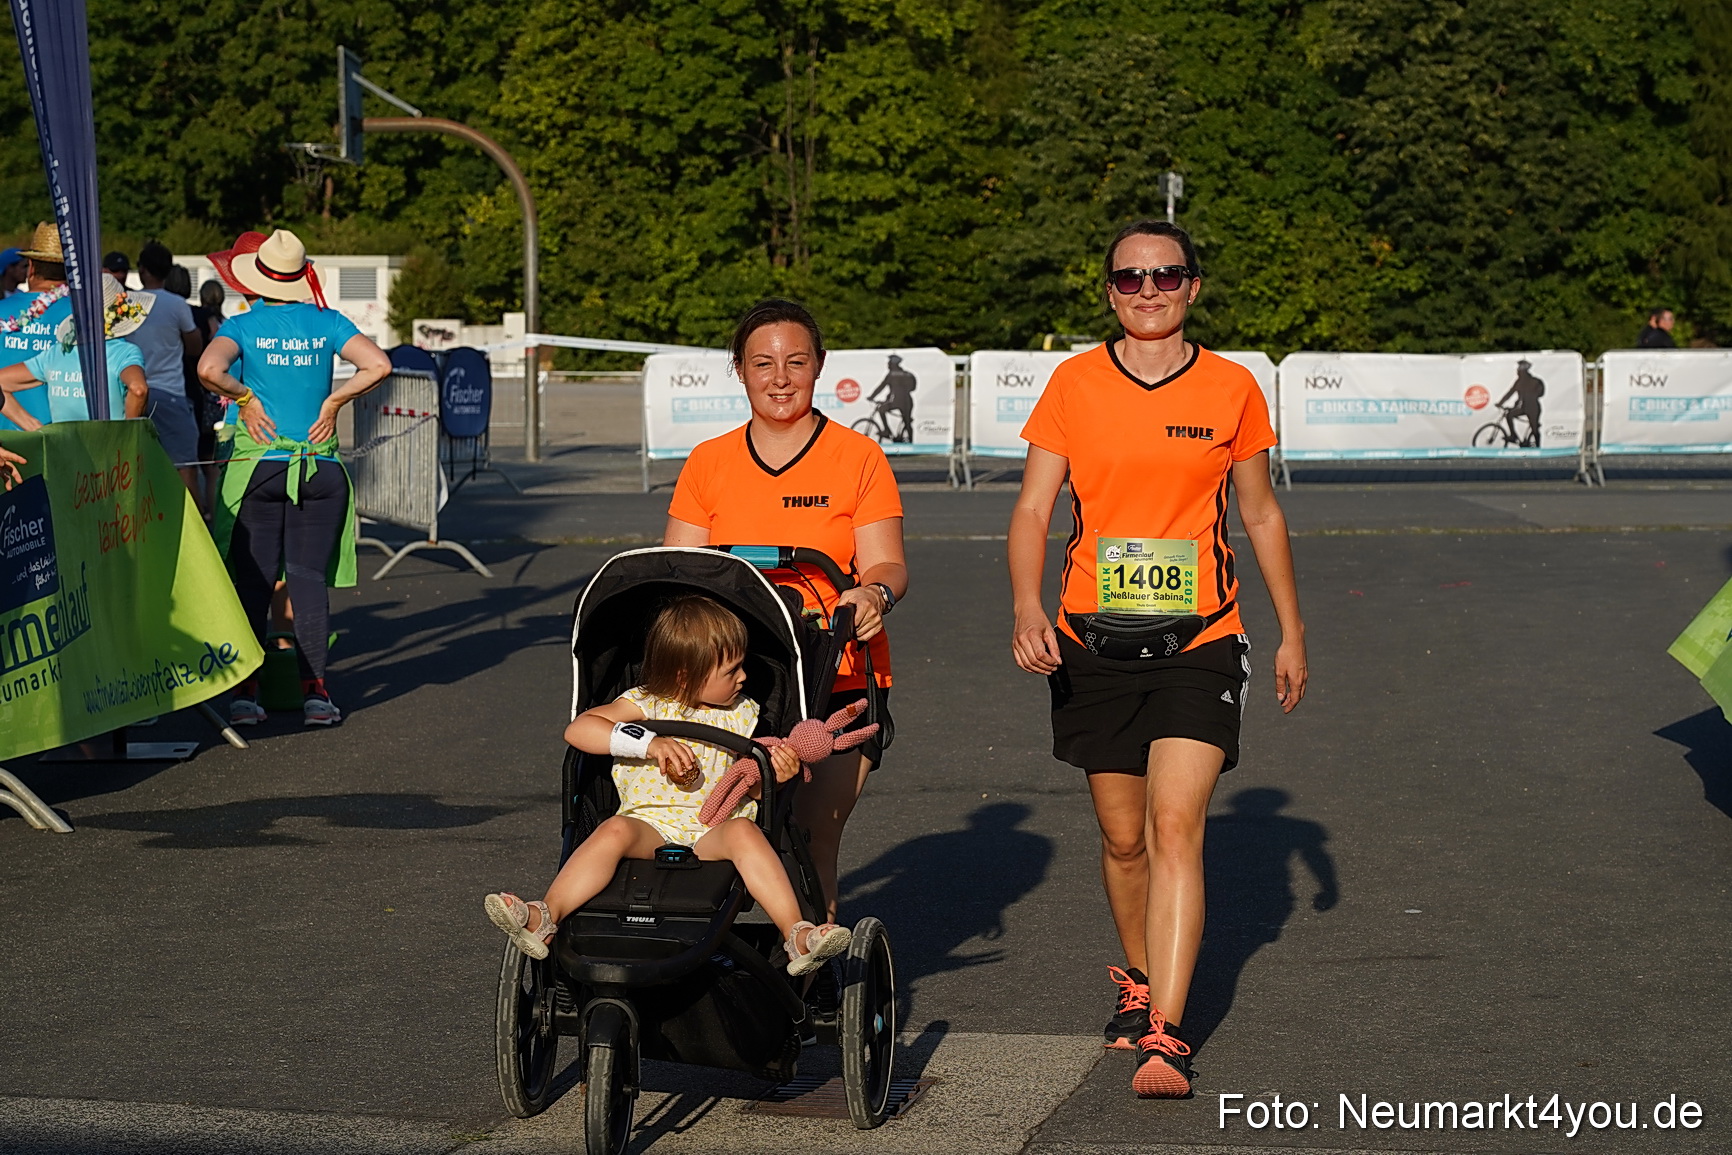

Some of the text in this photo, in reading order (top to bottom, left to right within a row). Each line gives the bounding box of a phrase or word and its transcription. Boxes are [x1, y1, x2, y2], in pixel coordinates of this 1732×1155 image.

[256, 336, 327, 351] Hier blüht ihr
[266, 353, 289, 366] Kind
[293, 354, 313, 366] auf
[670, 374, 710, 388] NOW
[996, 373, 1035, 388] NOW
[1304, 375, 1343, 390] NOW
[1629, 373, 1668, 388] NOW
[73, 387, 87, 398] au
[1308, 400, 1365, 414] E-BIKES
[1165, 425, 1215, 441] THULE
[782, 495, 830, 508] THULE
[3, 516, 45, 549] Fischer
[6, 536, 47, 560] AUTOMOBILE
[1102, 567, 1111, 603] WALK
[1113, 564, 1182, 591] 1408
[1184, 570, 1193, 605] 2022
[1110, 591, 1184, 602] Neßlauer Sabina
[626, 915, 656, 923] THULE
